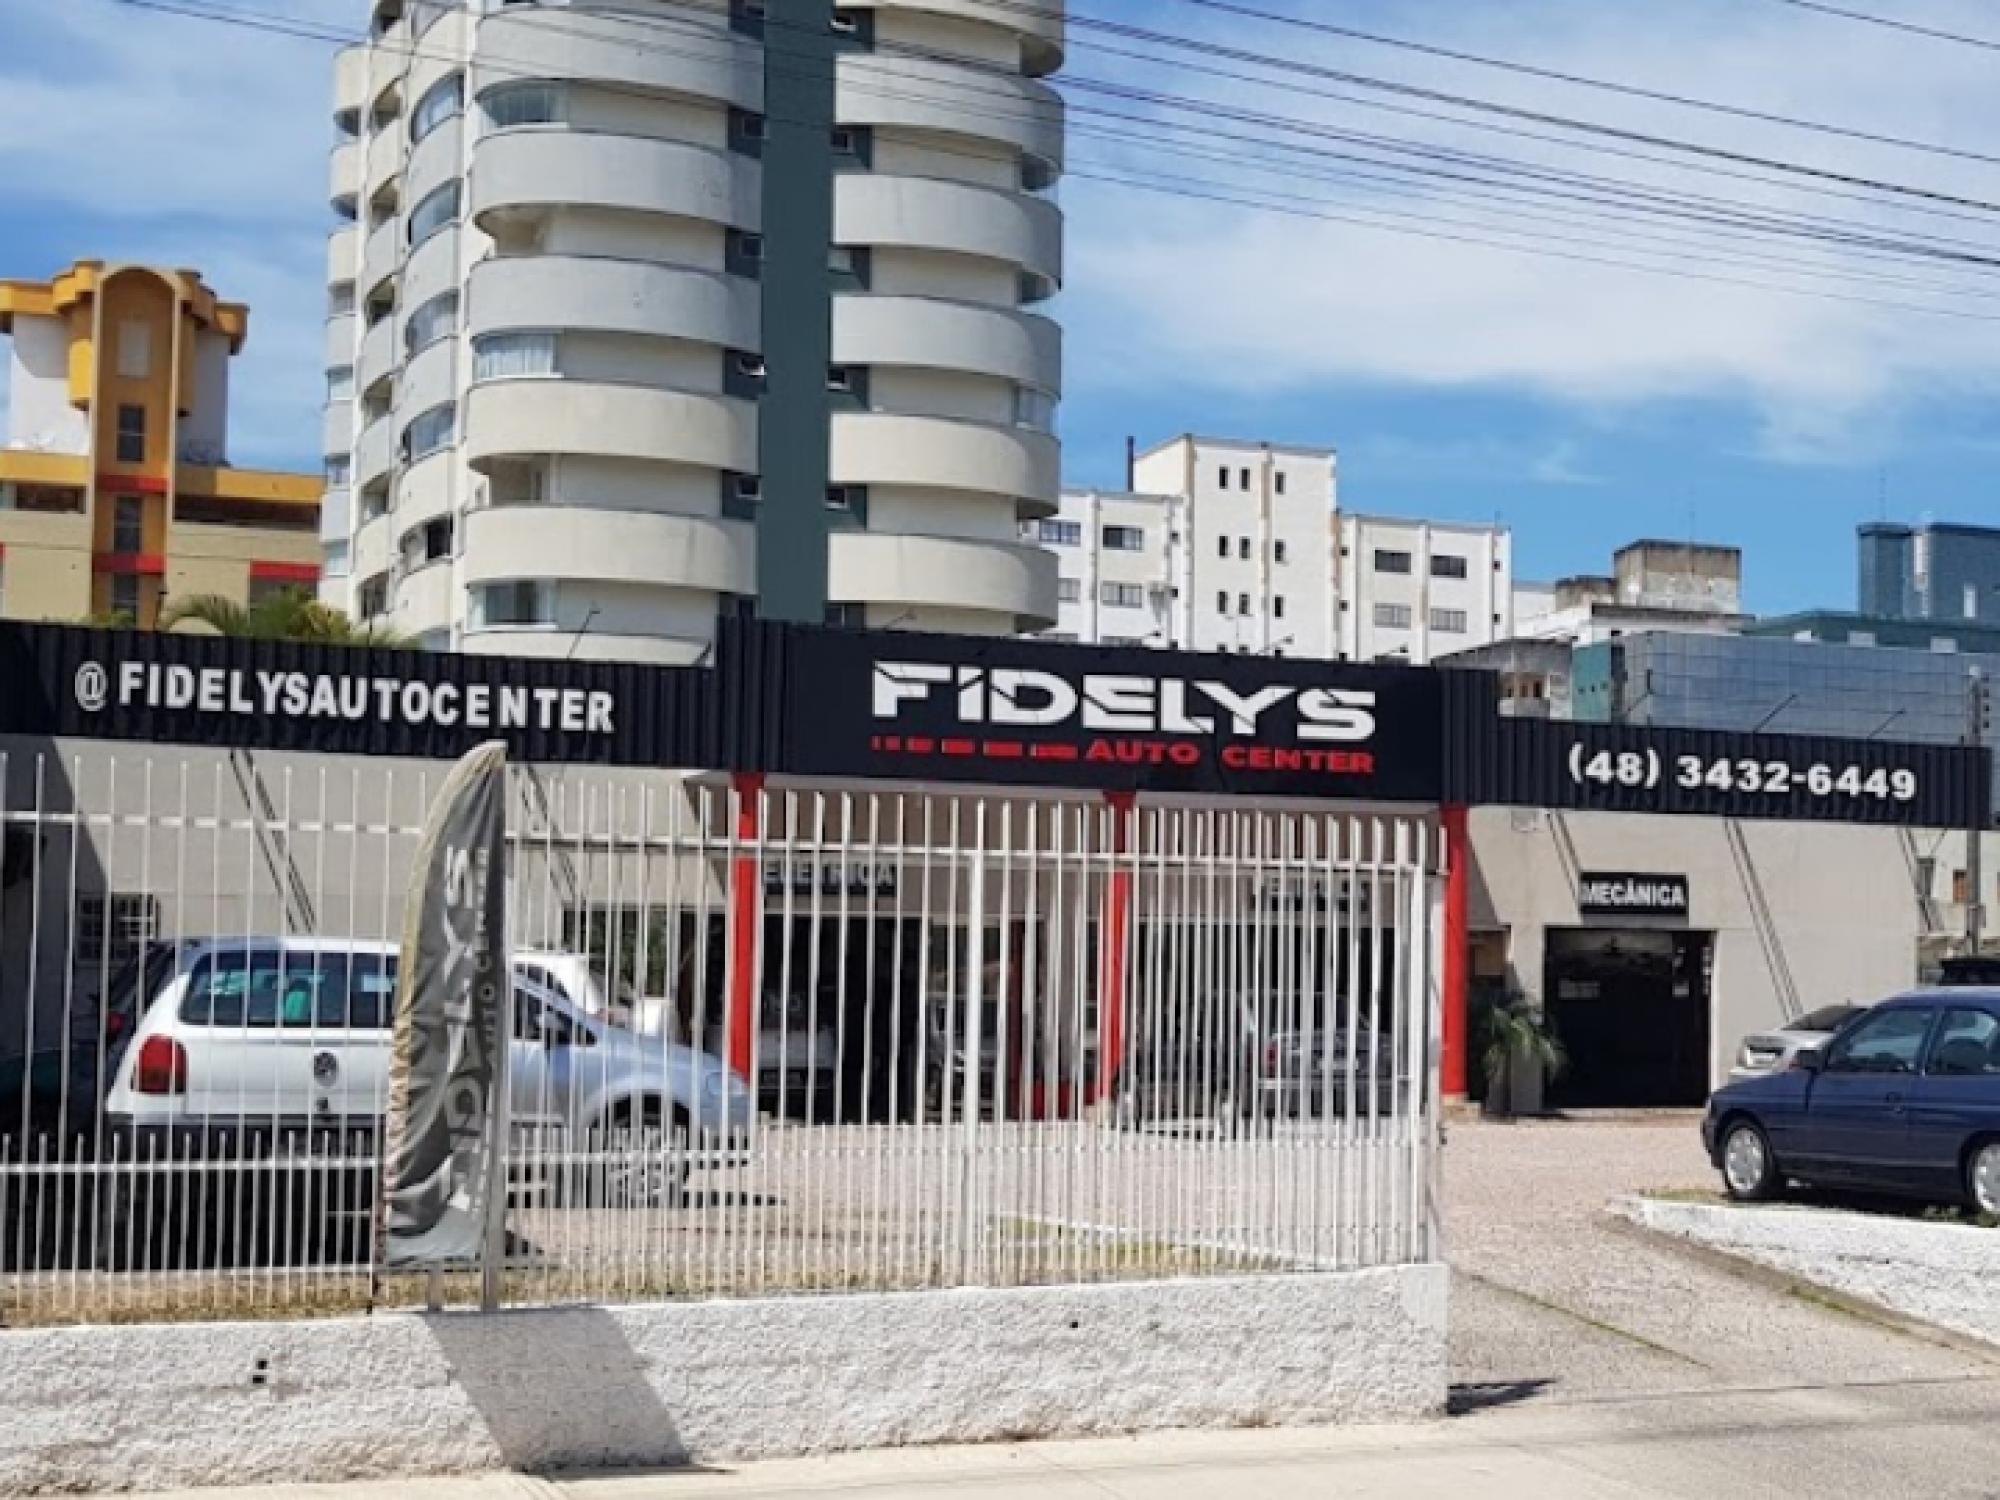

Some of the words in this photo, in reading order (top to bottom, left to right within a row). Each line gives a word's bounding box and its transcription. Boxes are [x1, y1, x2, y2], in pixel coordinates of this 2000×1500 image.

[872, 660, 1376, 742] FIDELYS
[1084, 739, 1201, 765] AUTO
[1221, 746, 1375, 774] CENTER
[1568, 741, 1661, 789] (48)
[1676, 754, 1918, 802] 3432-6449
